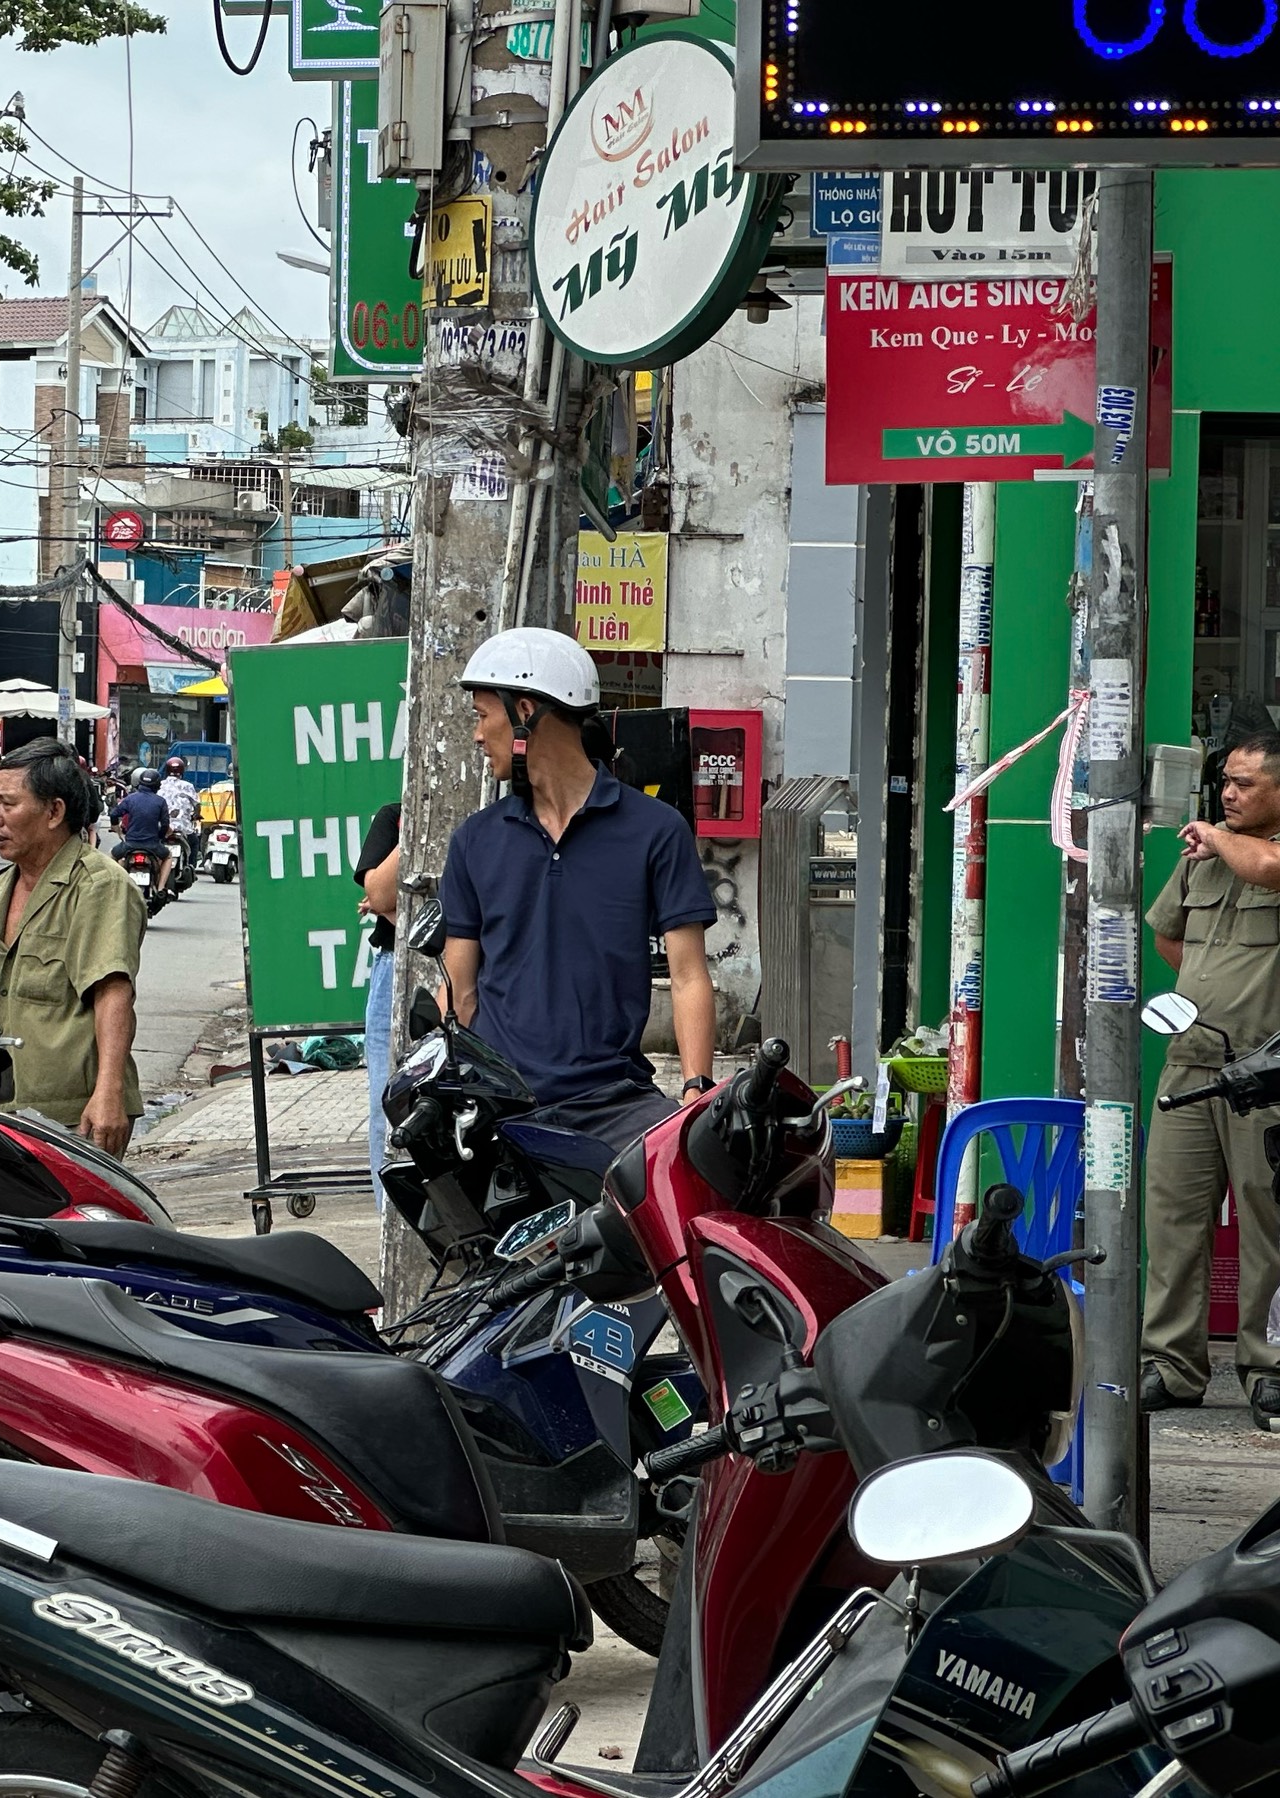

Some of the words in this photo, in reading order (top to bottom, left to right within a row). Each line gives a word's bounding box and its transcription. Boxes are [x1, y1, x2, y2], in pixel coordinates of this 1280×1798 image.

[566, 180, 626, 246] Hair
[633, 116, 711, 188] Salon
[830, 210, 852, 227] LỘ
[553, 226, 639, 321] Mỹ
[657, 148, 743, 239] Mỹ
[931, 250, 985, 261] Vào
[997, 250, 1051, 260] 15m
[840, 282, 898, 312] KEM
[908, 284, 978, 308] AICE
[870, 328, 924, 348] Kem
[931, 327, 978, 348] Que
[1002, 325, 1031, 348] Ly
[917, 431, 956, 456] VÔ
[966, 434, 1021, 455] 50M
[610, 543, 646, 568] HÀ
[620, 577, 654, 606] Thẻ
[178, 622, 247, 649] guardian
[589, 612, 629, 641] Liền
[699, 754, 736, 767] PCCC
[575, 1354, 607, 1376] 125
[32, 1591, 256, 1708] Sirius
[934, 1648, 1037, 1720] YAMAHA
